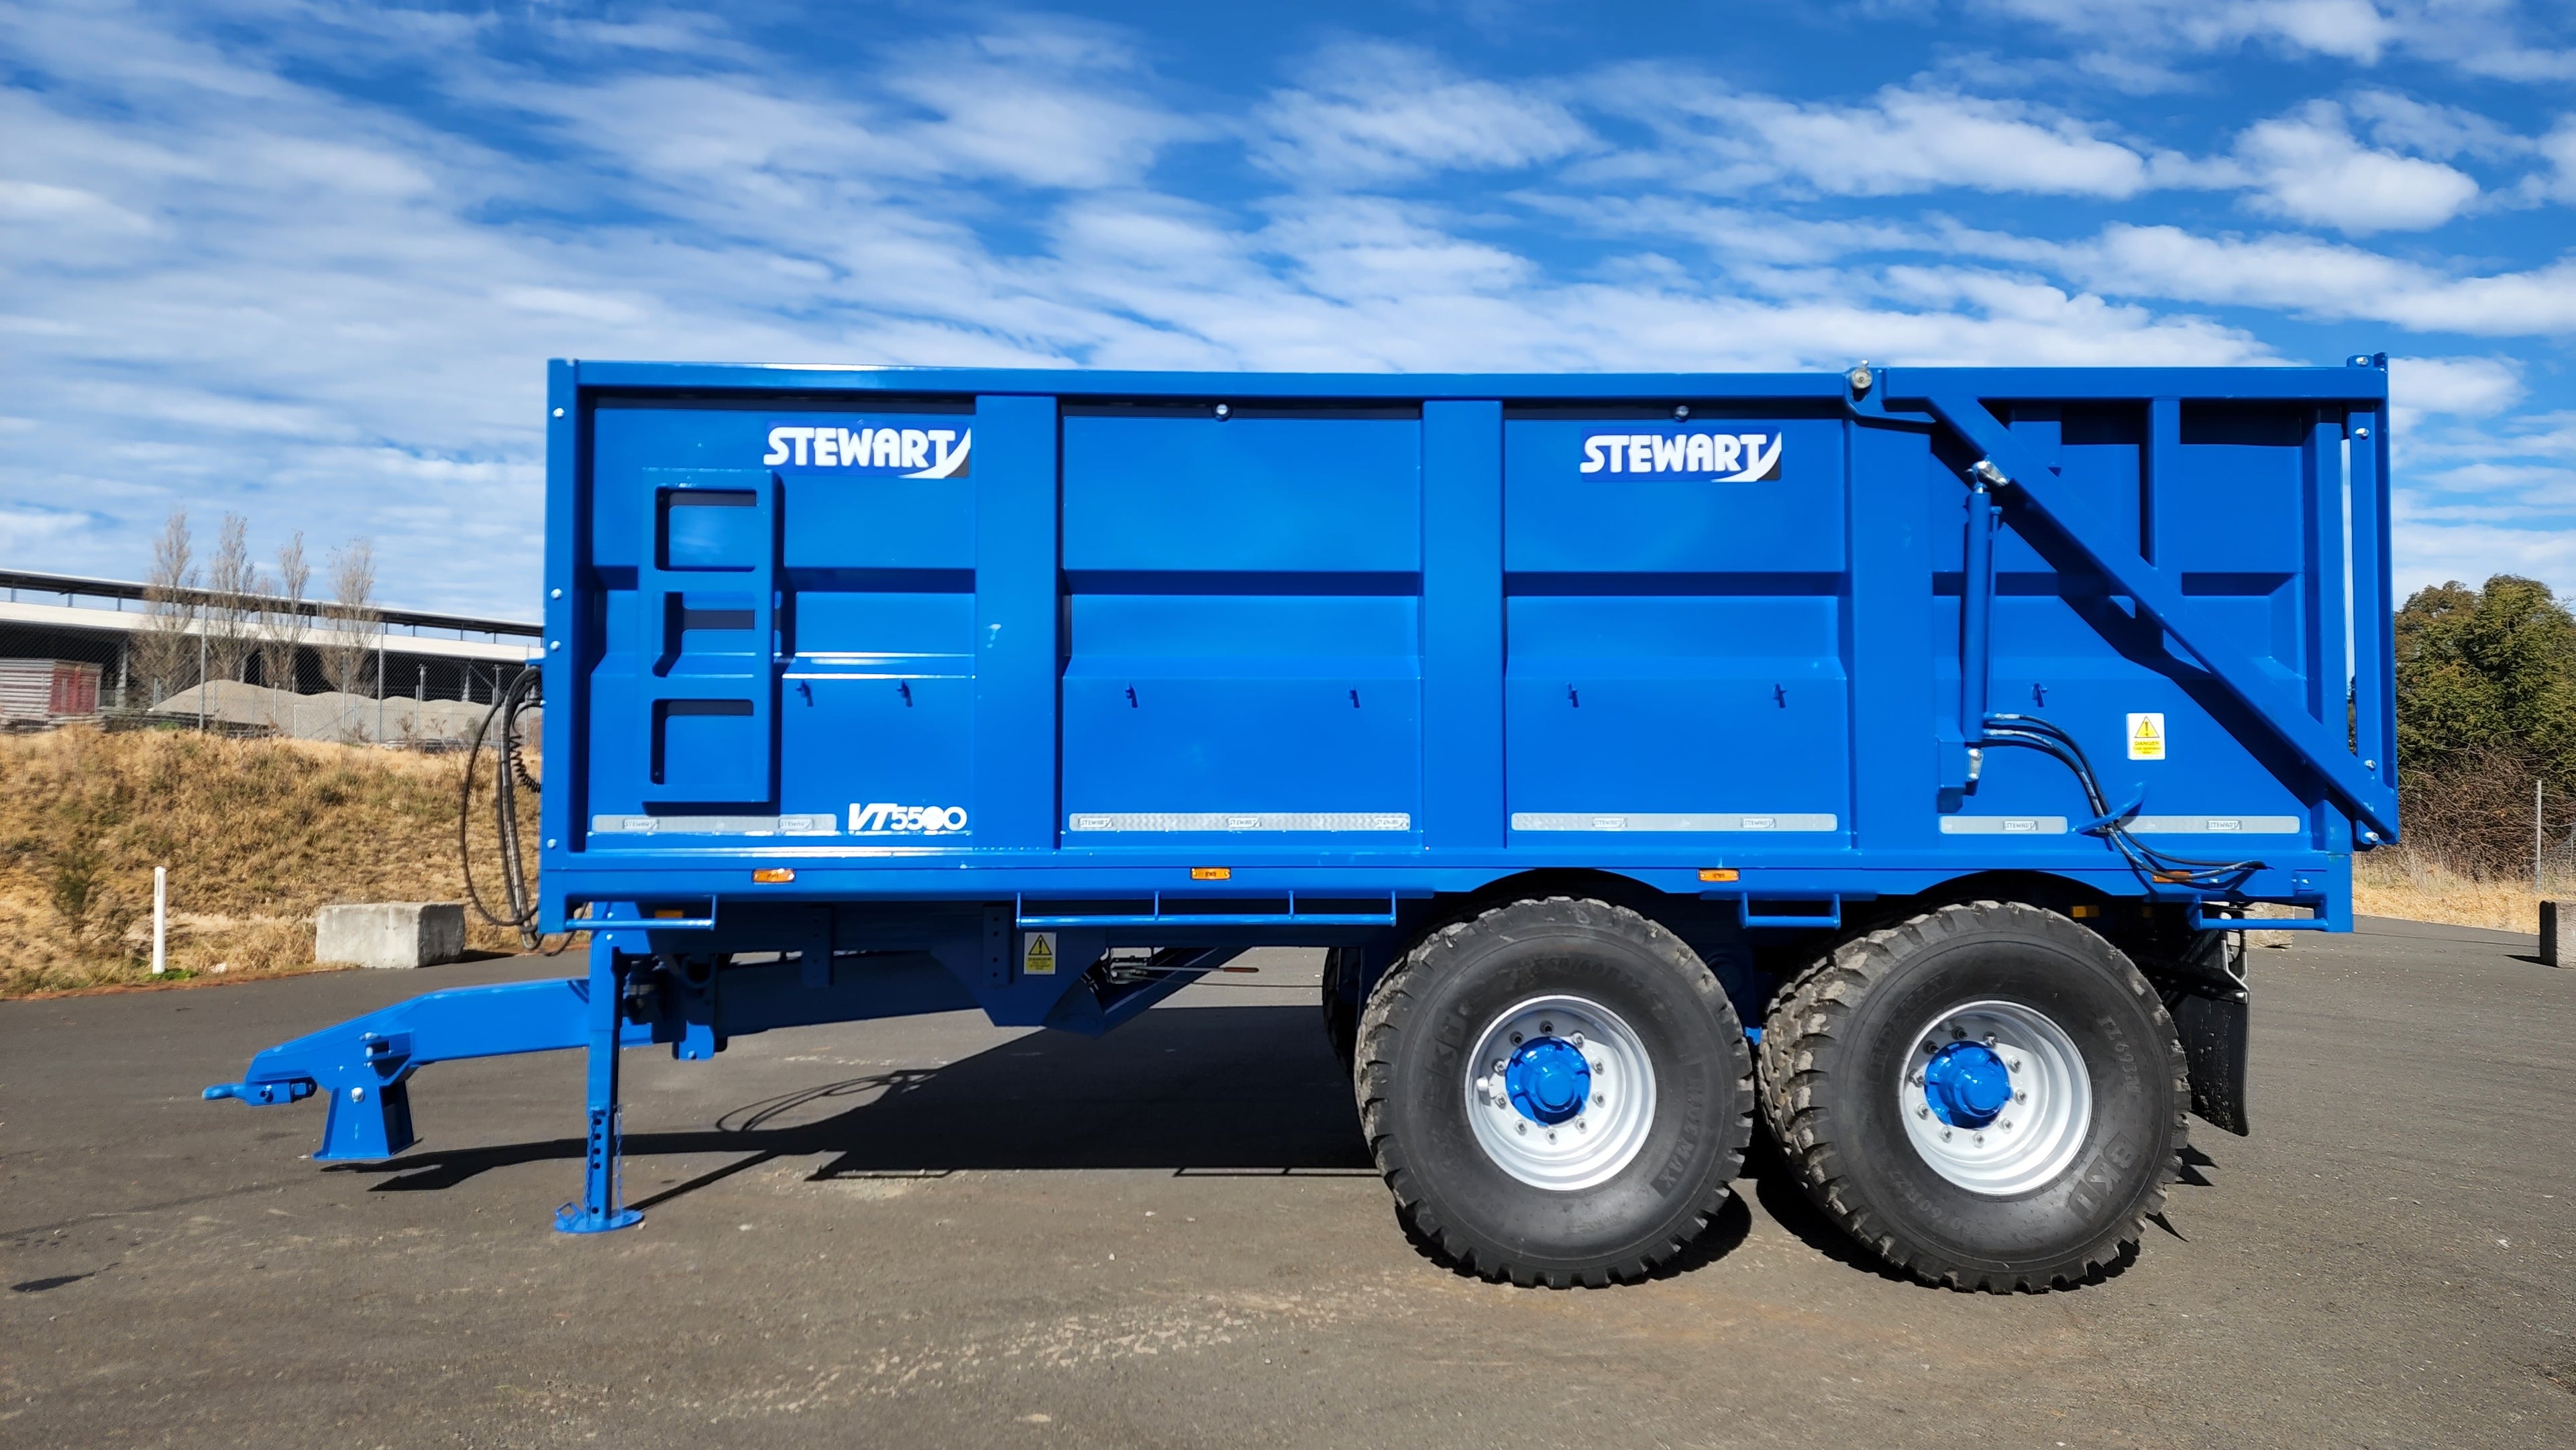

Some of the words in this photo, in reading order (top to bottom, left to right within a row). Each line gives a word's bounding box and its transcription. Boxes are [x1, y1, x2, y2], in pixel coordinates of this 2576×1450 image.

[763, 427, 971, 479] STEWART
[1580, 431, 1782, 482] STEWART
[2076, 1139, 2137, 1221] BKT
